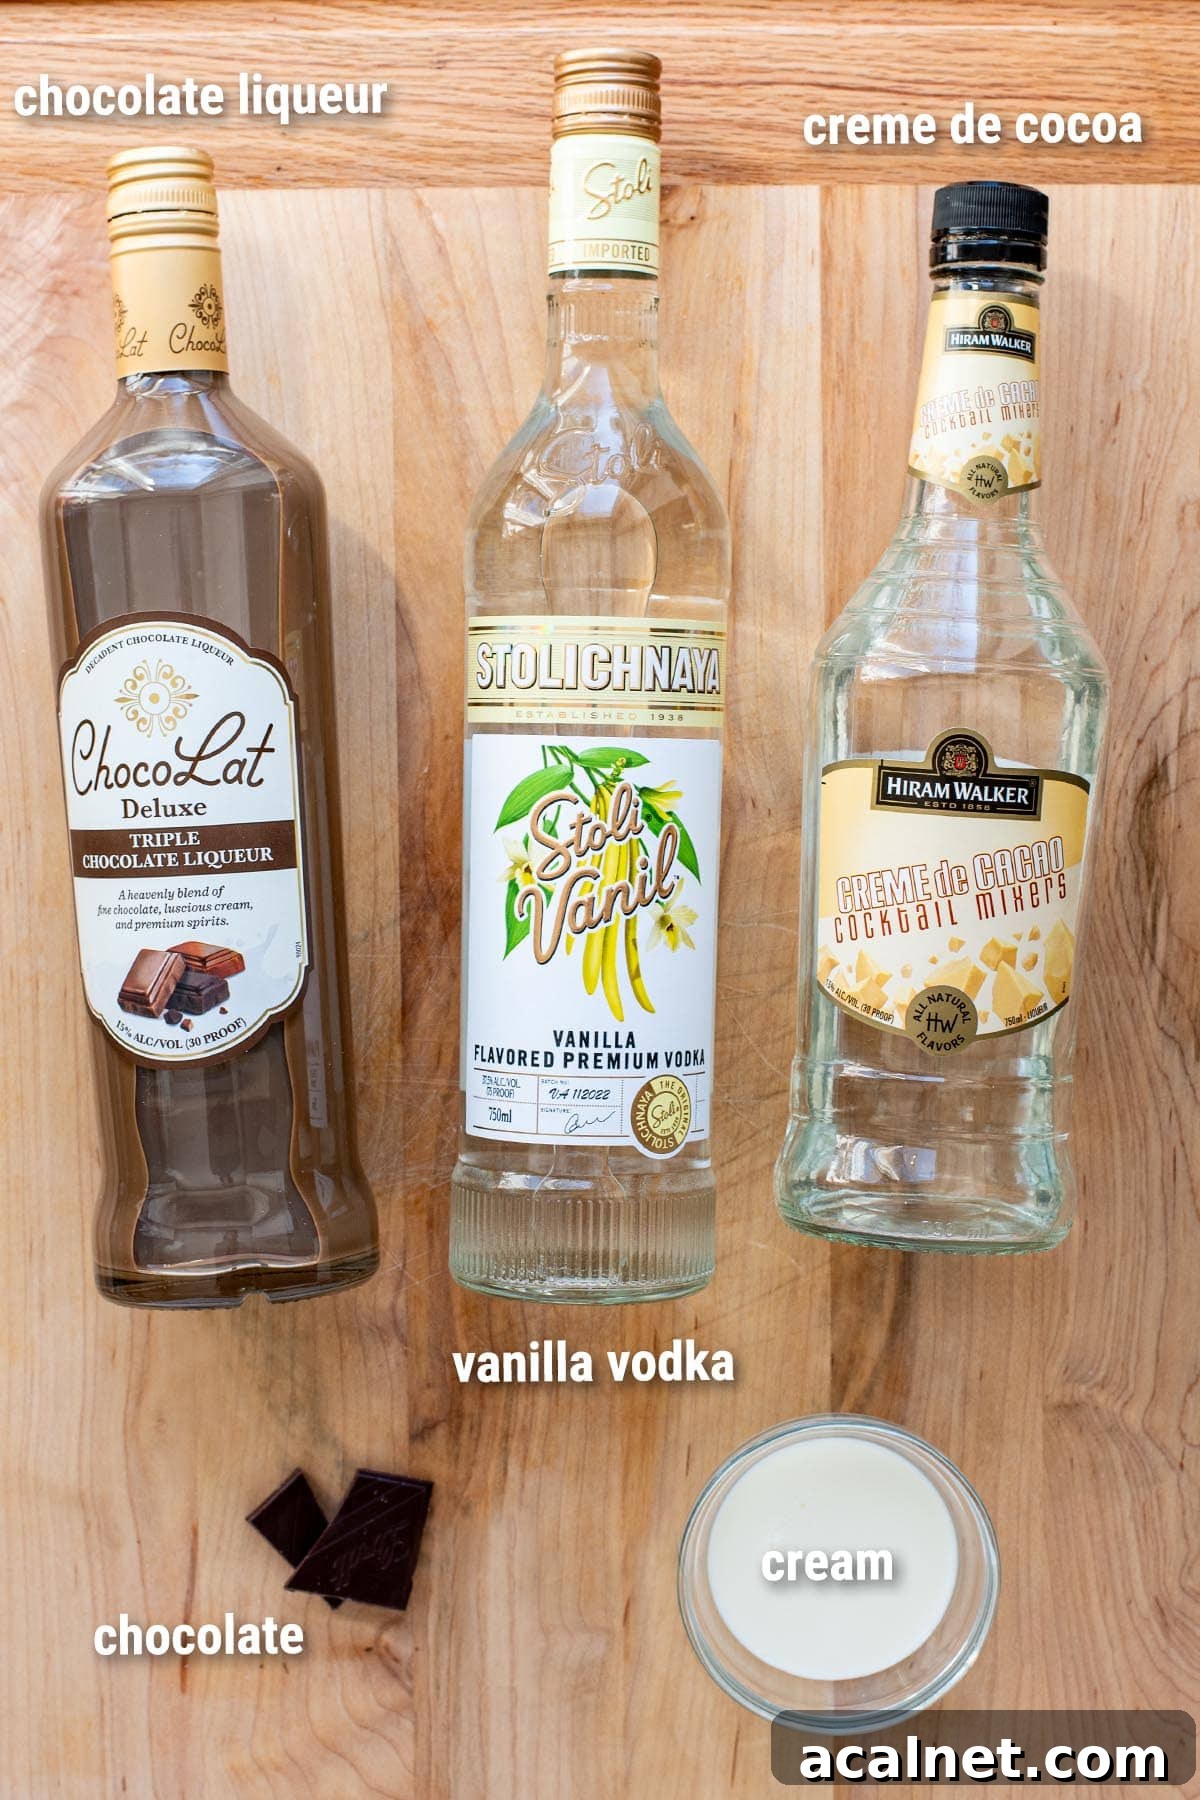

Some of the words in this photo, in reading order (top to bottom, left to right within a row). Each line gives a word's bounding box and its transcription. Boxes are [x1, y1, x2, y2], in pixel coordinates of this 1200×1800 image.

[584, 158, 652, 220] Stoli
[583, 243, 650, 261] IMPORTED
[951, 333, 990, 346] HIRAM
[991, 334, 1032, 353] WALKER
[974, 386, 995, 409] de
[84, 640, 124, 674] DECADENT
[126, 634, 188, 646] CHOCOLATE
[191, 639, 234, 666] LIQUEUR
[476, 642, 721, 694] STOLICHNAYA
[515, 710, 638, 721] ESTABLISHED
[651, 713, 684, 722] 1938
[72, 711, 275, 796] ChocoLat
[887, 776, 950, 799] HIRAM
[953, 781, 1029, 805] WALKER
[121, 798, 207, 819] Deluxe
[924, 801, 957, 810] ESTD
[962, 803, 991, 811] 1858
[129, 832, 201, 849] TRIPLE
[530, 782, 644, 881] Stoli
[82, 852, 180, 869] CHOCOLATE
[184, 847, 274, 869] LIQUEUR
[836, 864, 933, 914] CREME
[934, 860, 969, 899] de
[972, 836, 1064, 891] CACAO
[118, 890, 126, 900] A
[128, 888, 175, 901] heavenly
[177, 886, 209, 899] blend
[211, 885, 225, 898] of
[517, 824, 679, 965] Vanil
[97, 904, 112, 917] fine
[113, 904, 162, 916] chocolate,
[164, 903, 212, 914] luscious
[214, 901, 254, 912] cream,
[834, 900, 958, 944] cocktail
[975, 872, 1067, 921] mixers
[115, 919, 133, 930] and
[134, 919, 184, 931] premium
[187, 916, 230, 930] spirits.
[871, 1007, 895, 1025] PROOF)
[913, 1003, 928, 1022] ALL
[926, 992, 972, 1024] NATURAL
[1027, 1002, 1049, 1020] LIQUEUR
[116, 1020, 132, 1038] 15%
[133, 1033, 183, 1049] ALC/VOL
[185, 1038, 201, 1050] (30
[203, 1017, 247, 1044] PROOF)
[926, 1012, 959, 1033] HW
[553, 1030, 636, 1049] VANILLA
[916, 1031, 965, 1052] FLAVORS
[474, 1044, 554, 1068] FLAVORED
[563, 1052, 659, 1069] PREMIUM
[665, 1048, 705, 1068] VODKA
[549, 1088, 570, 1100] VA
[572, 1088, 611, 1100] 112022
[489, 1106, 512, 1123] 750ml
[651, 1101, 675, 1129] Stoli
[660, 1080, 675, 1089] THE
[677, 1086, 689, 1135] ORIGINAL
[636, 1090, 674, 1149] STOLICHNAYA
